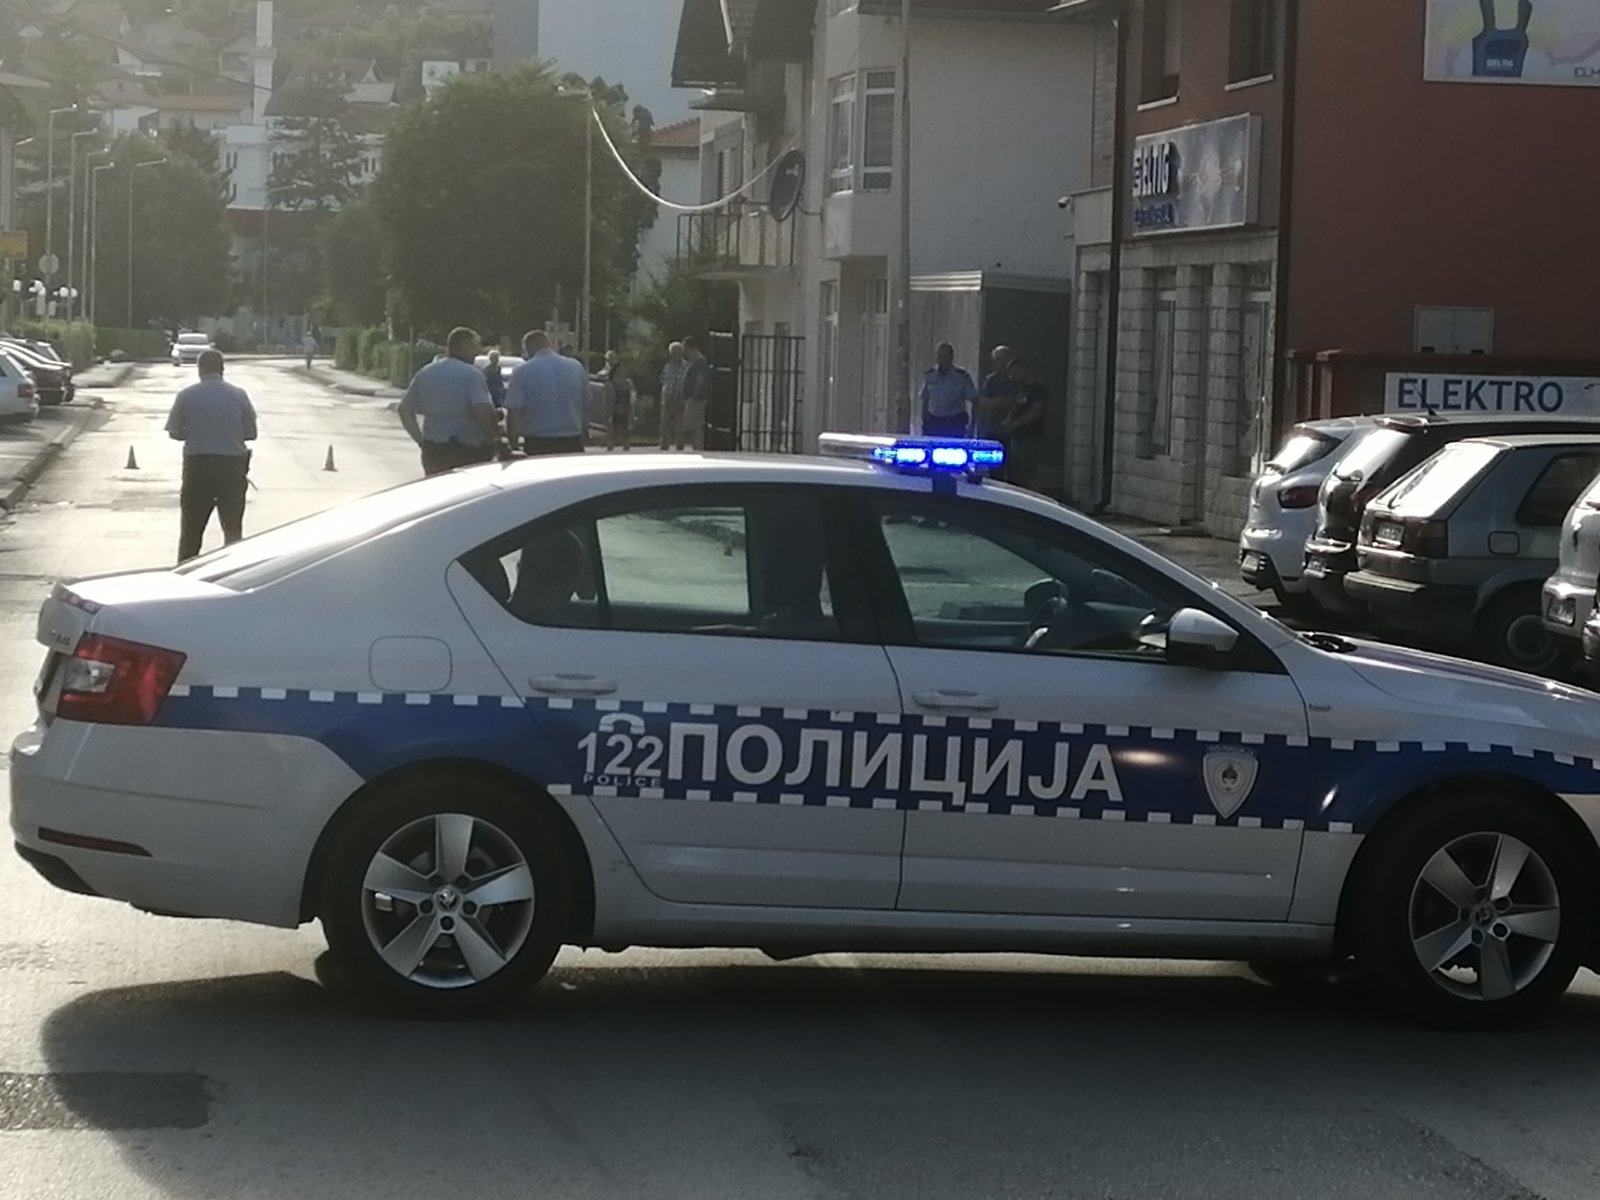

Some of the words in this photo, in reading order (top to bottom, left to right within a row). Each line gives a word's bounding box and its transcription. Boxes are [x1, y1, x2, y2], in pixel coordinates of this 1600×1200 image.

[1399, 377, 1564, 413] ELEKTRO
[577, 731, 664, 778] 122
[667, 722, 1124, 806] ПОЛИЦИЈА
[583, 773, 662, 788] POLICE
